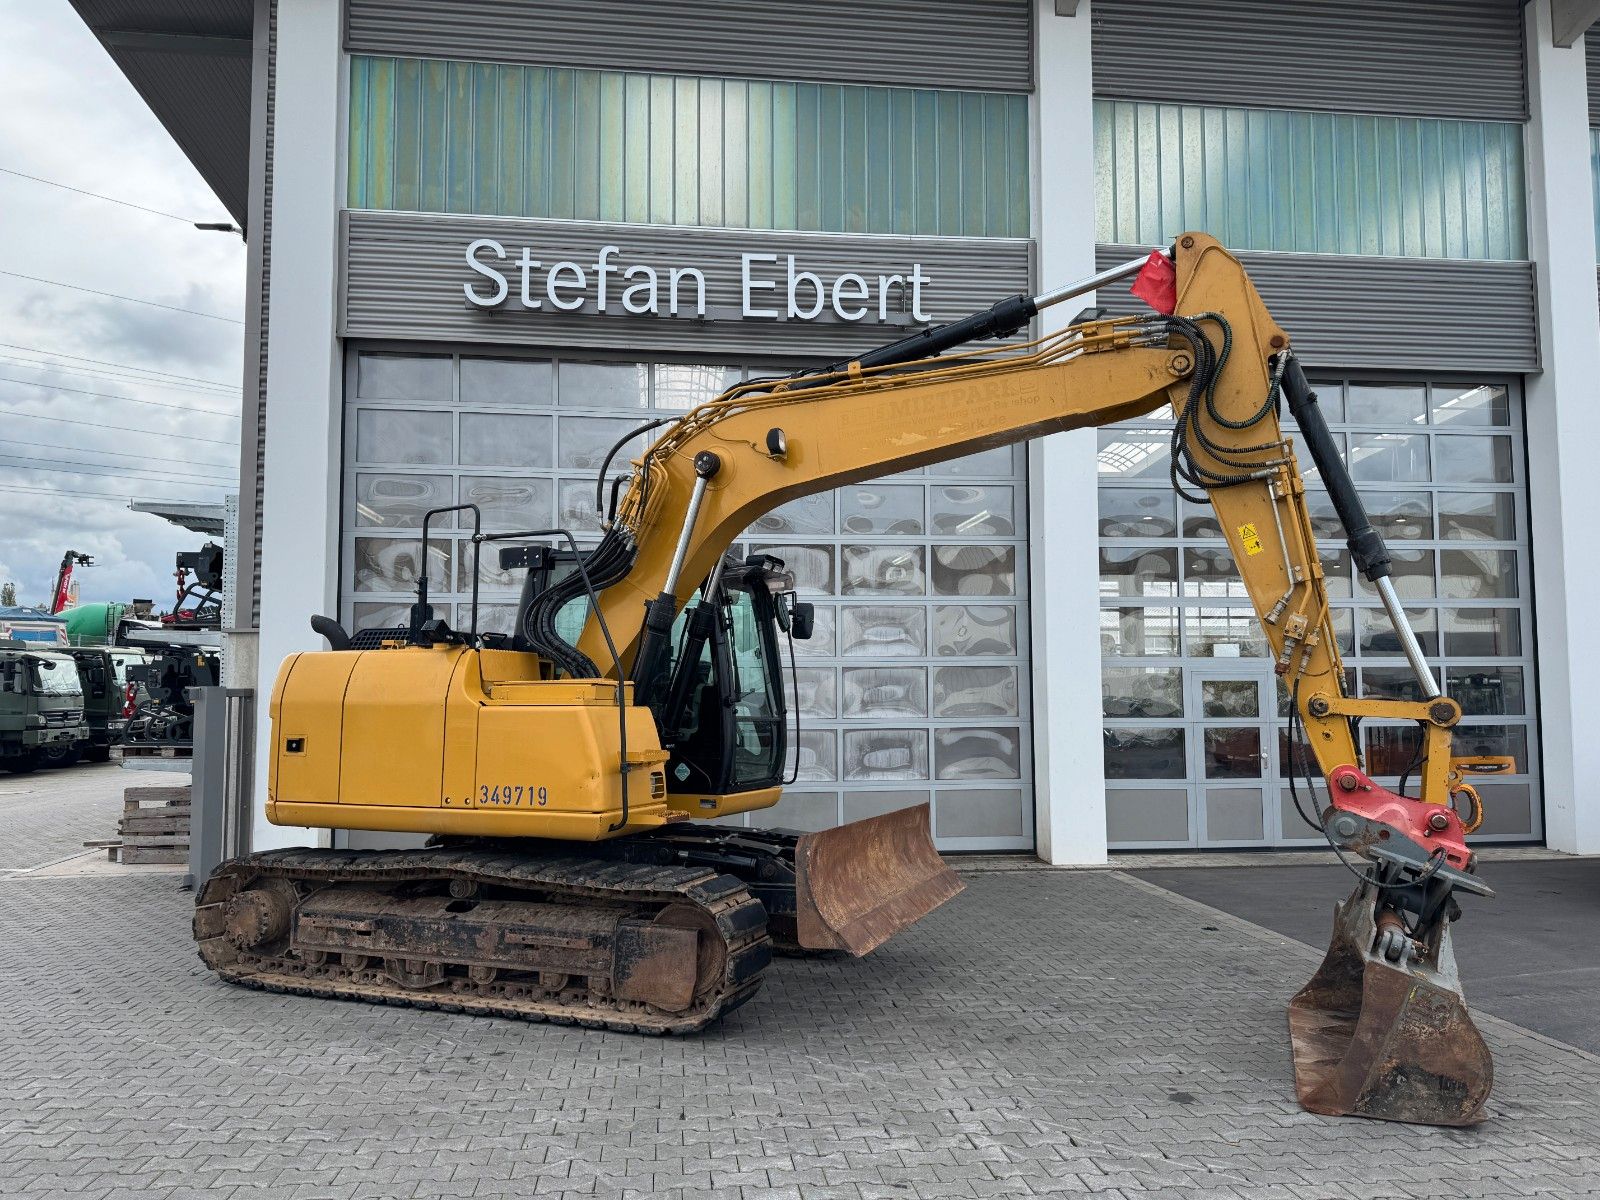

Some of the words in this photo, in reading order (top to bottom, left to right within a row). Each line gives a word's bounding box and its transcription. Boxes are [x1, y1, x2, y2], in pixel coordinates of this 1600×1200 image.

[463, 239, 706, 315] Stefan
[741, 253, 932, 322] Ebert
[479, 784, 547, 806] 349719
